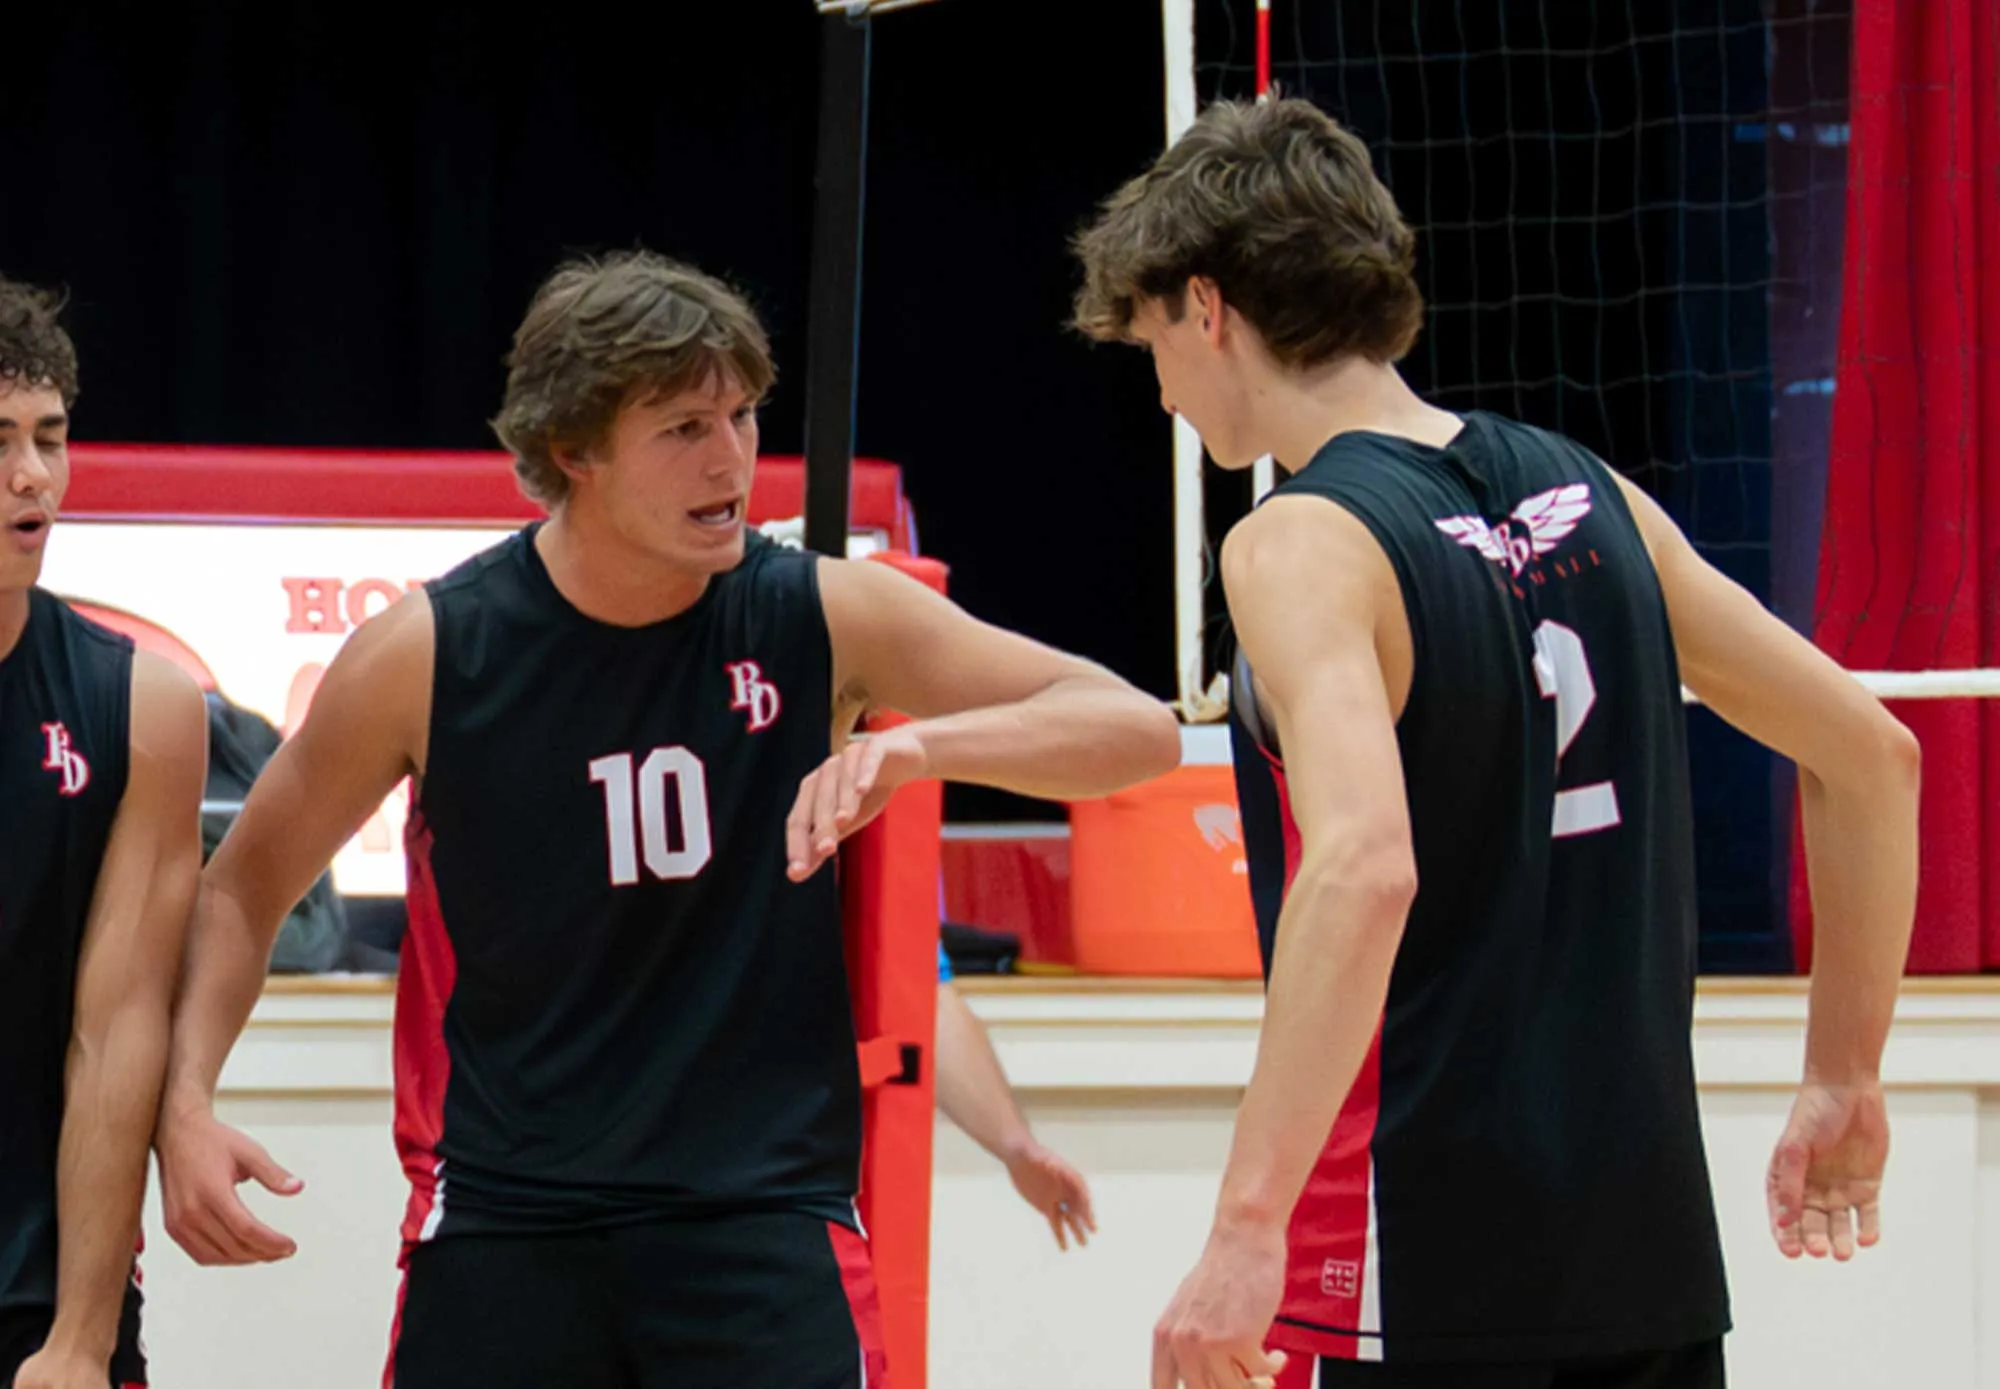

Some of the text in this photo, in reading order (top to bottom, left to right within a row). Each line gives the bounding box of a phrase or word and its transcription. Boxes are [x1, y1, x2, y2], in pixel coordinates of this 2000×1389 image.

[282, 577, 425, 633] HO
[1533, 618, 1621, 838] 2
[588, 745, 713, 886] 10
